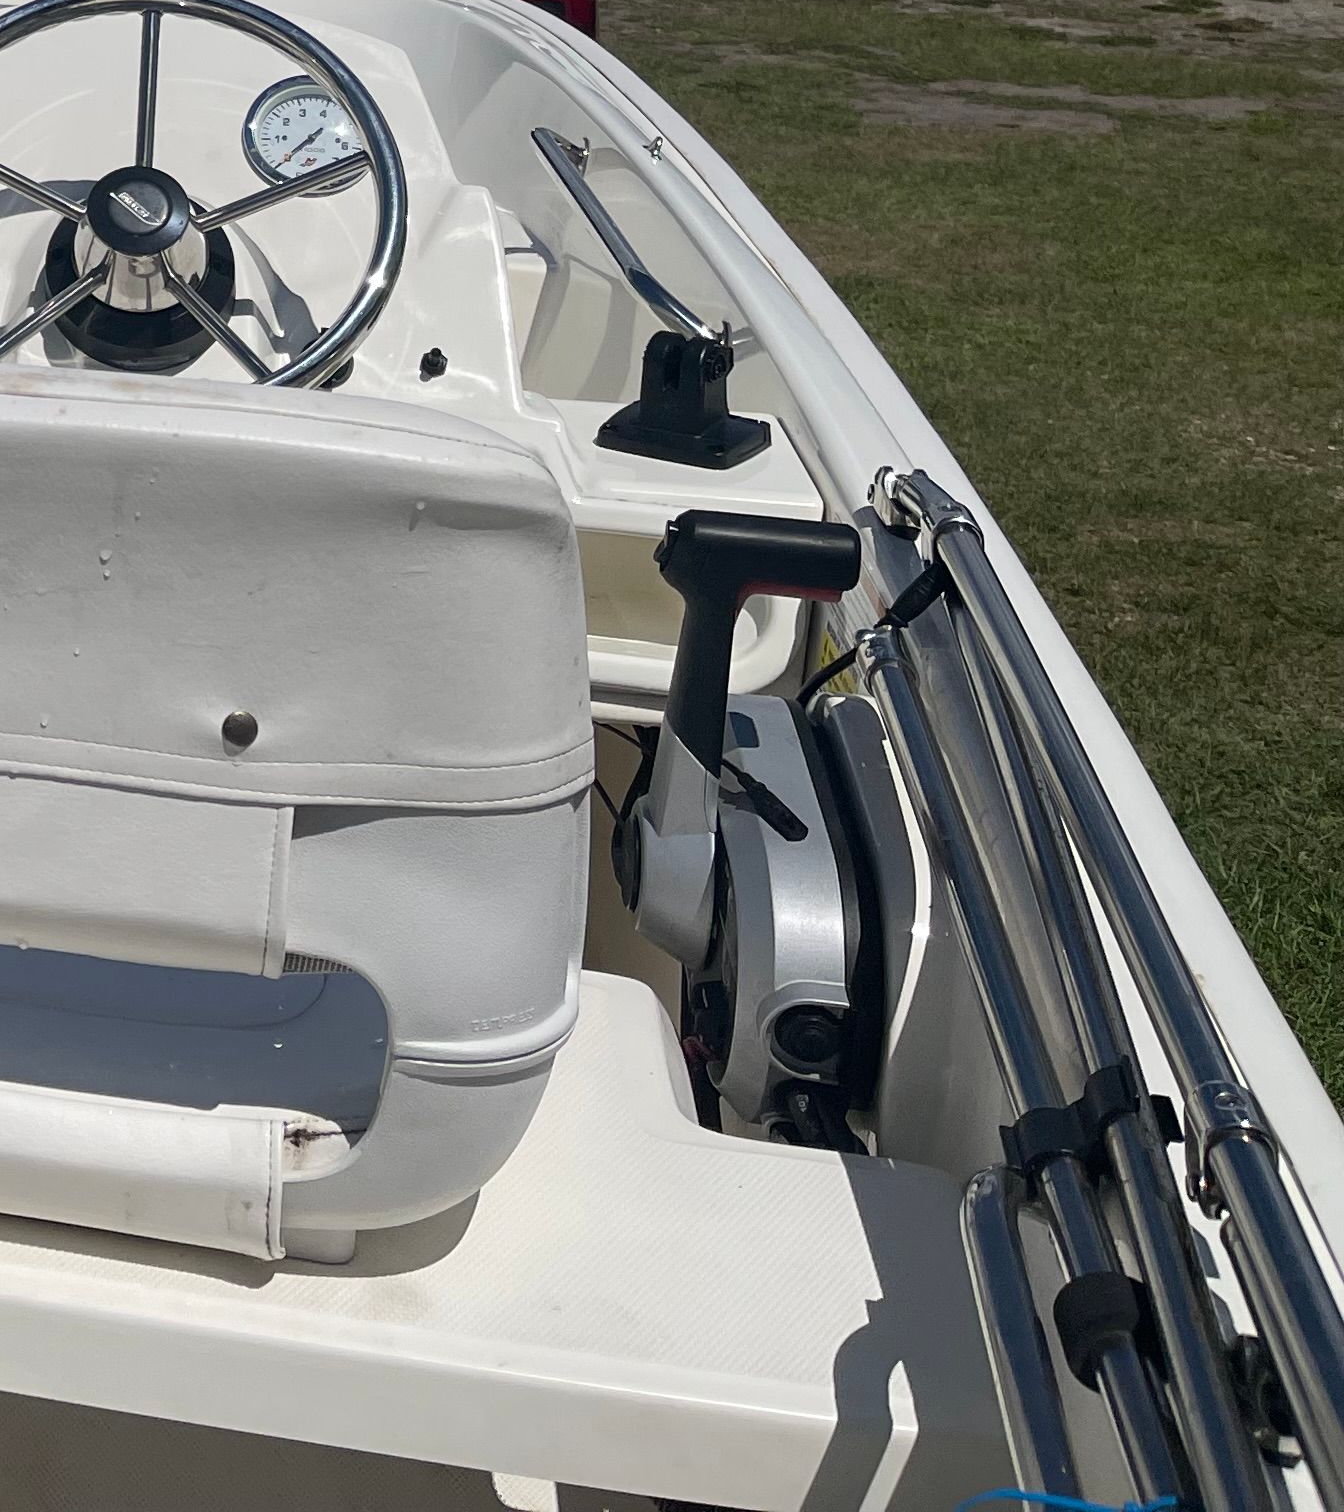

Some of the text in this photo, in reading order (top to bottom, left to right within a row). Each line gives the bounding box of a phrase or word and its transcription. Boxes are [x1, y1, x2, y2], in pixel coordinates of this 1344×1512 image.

[298, 109, 307, 117] 3
[319, 110, 327, 118] 4
[282, 118, 290, 126] 2
[341, 142, 349, 150] 6
